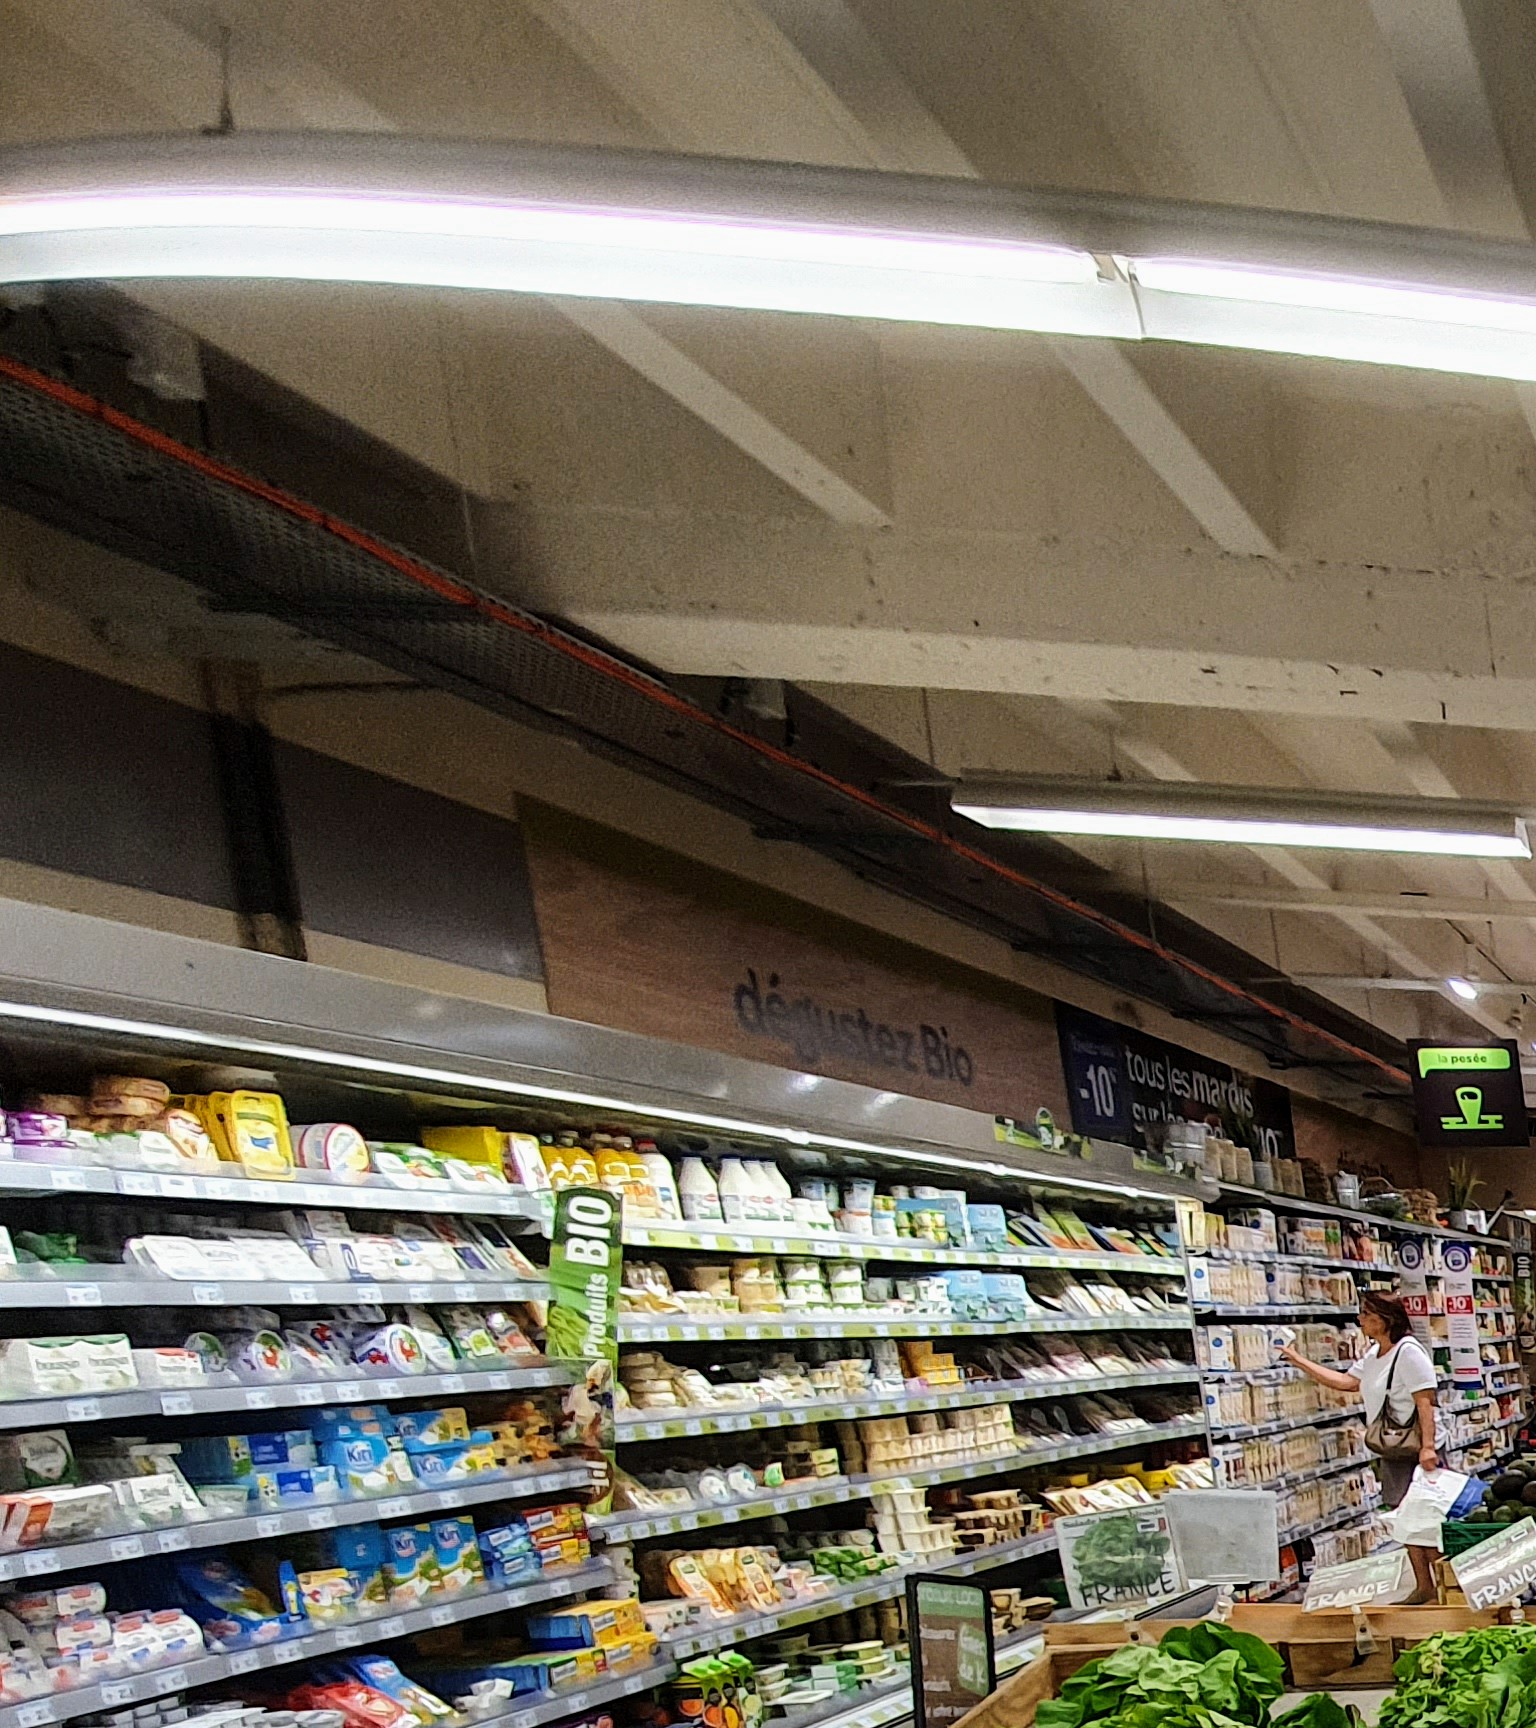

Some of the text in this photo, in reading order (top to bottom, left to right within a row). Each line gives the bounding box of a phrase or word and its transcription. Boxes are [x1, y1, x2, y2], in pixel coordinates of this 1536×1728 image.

[919, 1023, 974, 1086] Bio
[1450, 1053, 1488, 1065] pesée
[1124, 1045, 1165, 1092] tous
[1165, 1055, 1192, 1099] les
[1192, 1067, 1255, 1119] mardis
[565, 1196, 613, 1268] BIO
[1516, 1255, 1531, 1278] BIO
[582, 1273, 609, 1358] Produits
[1078, 1571, 1176, 1607] FRANCE
[1305, 1581, 1390, 1611] FRANCE
